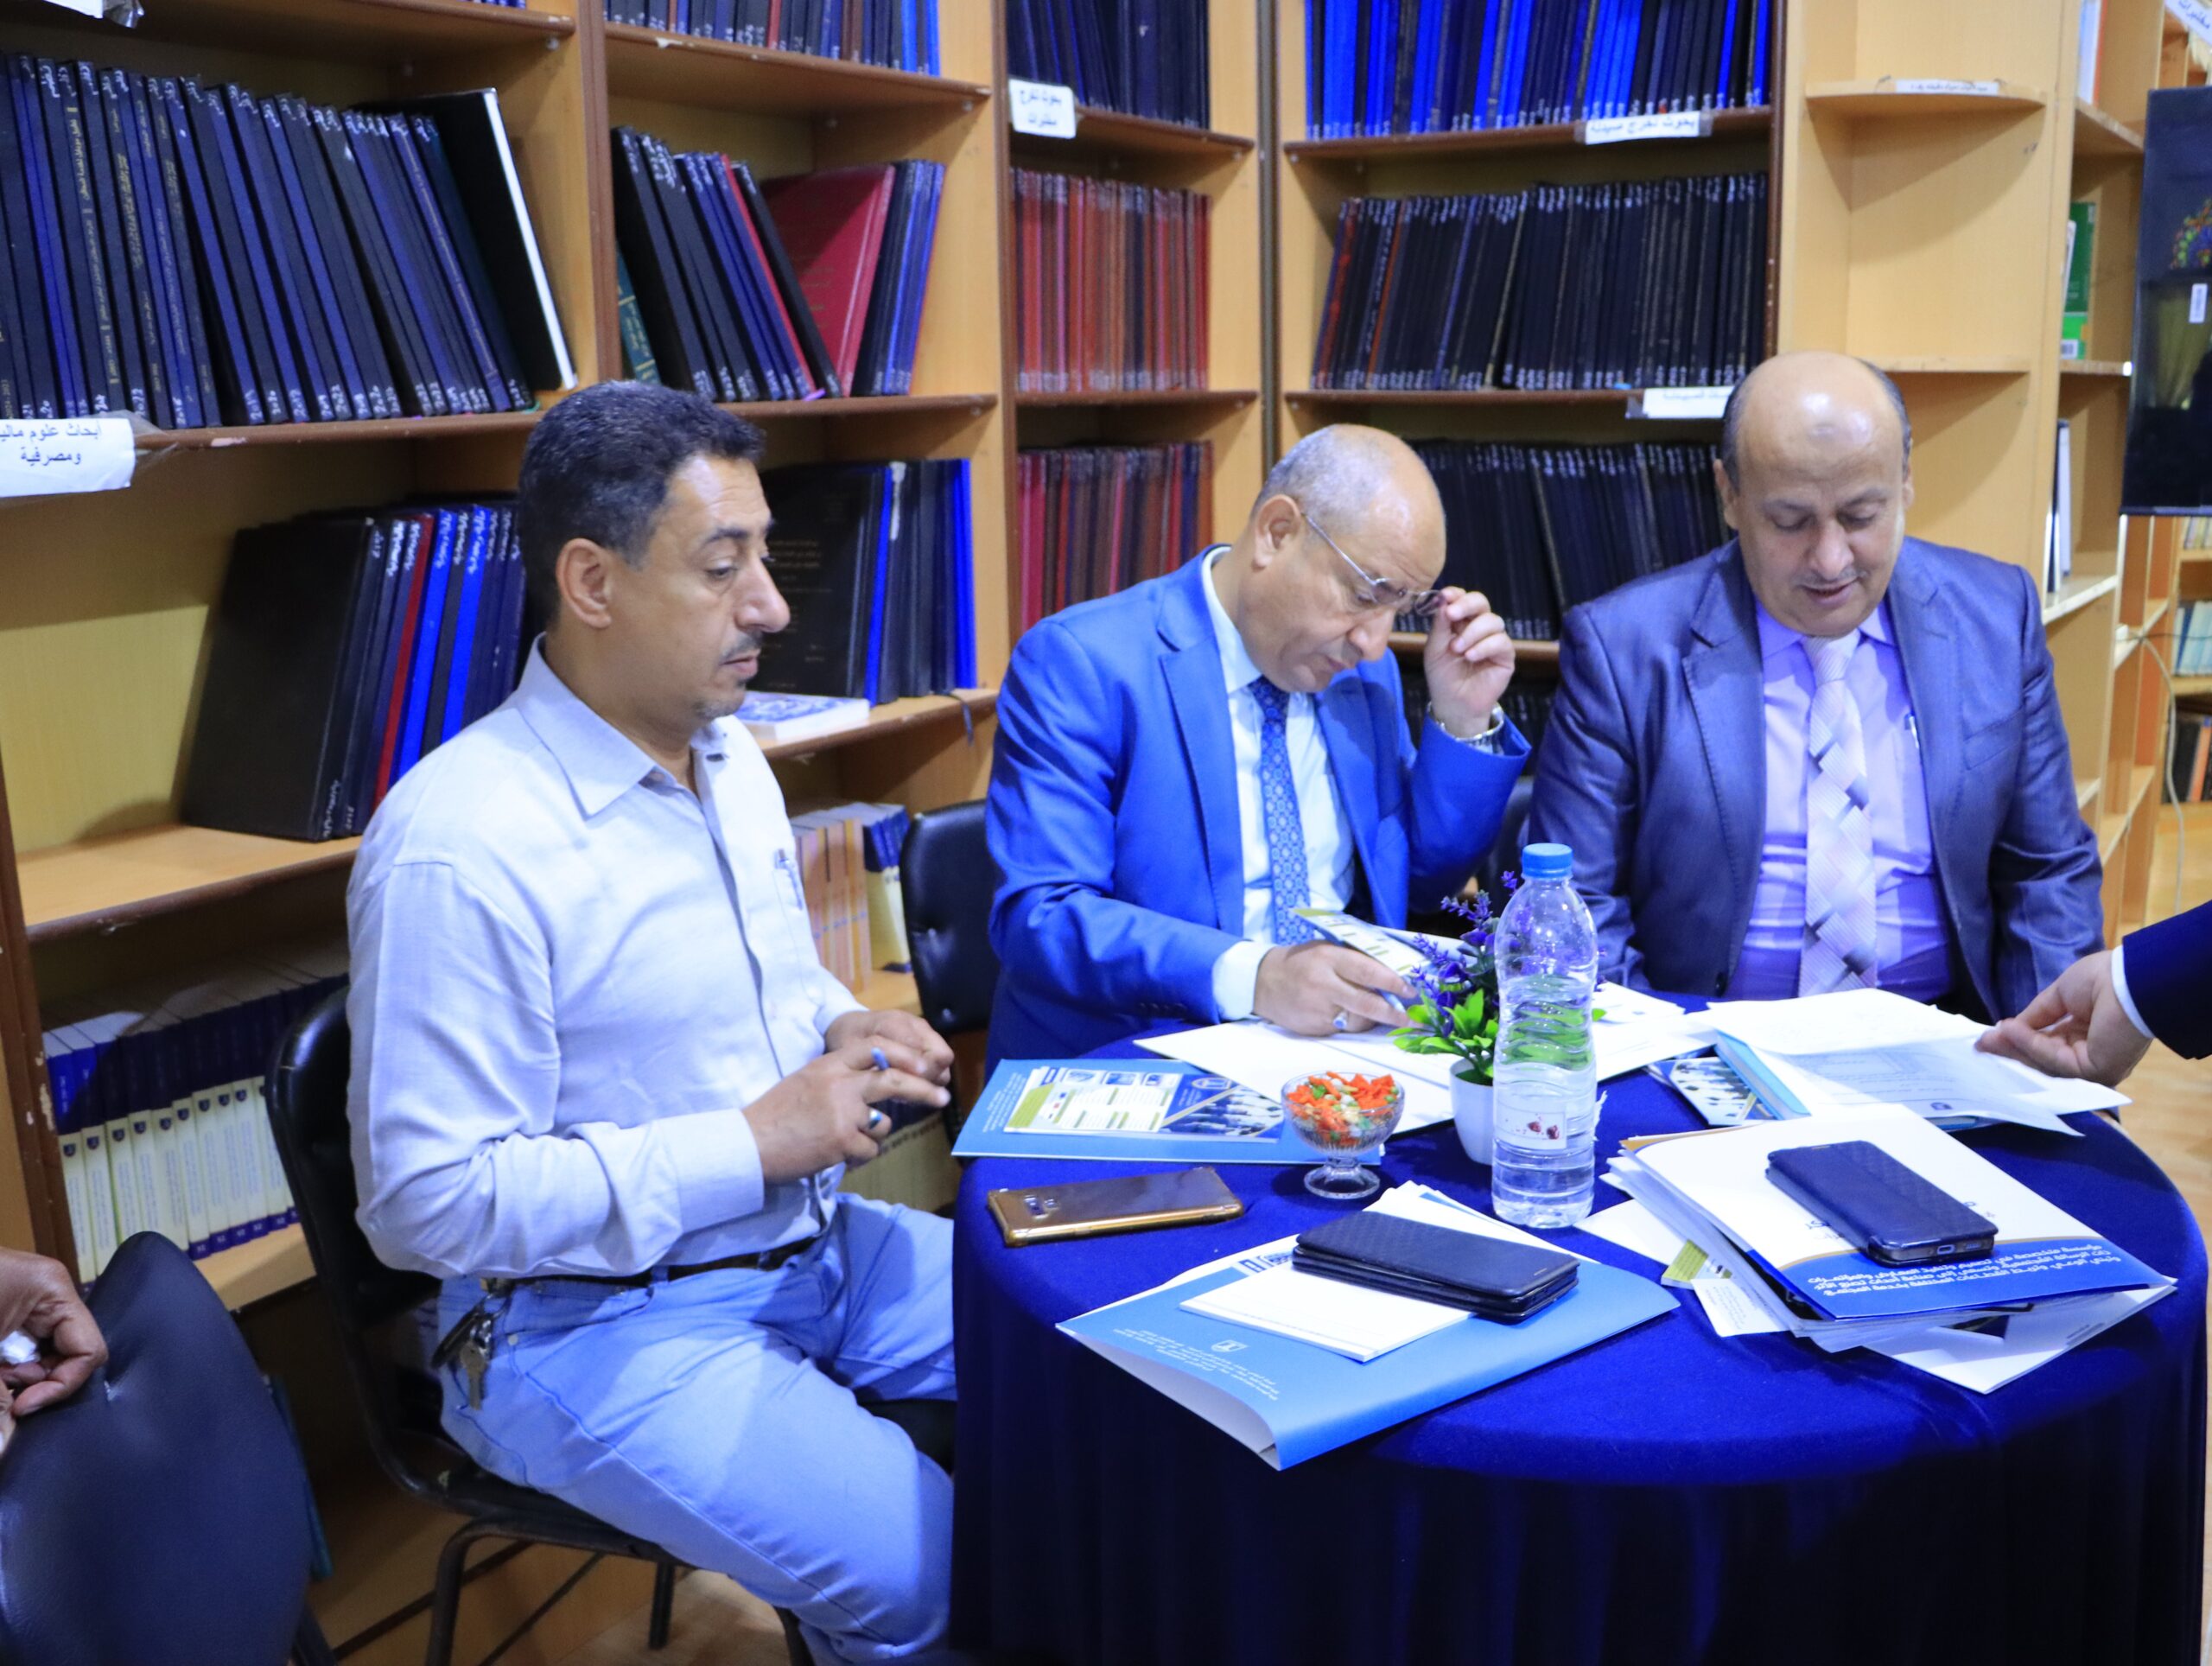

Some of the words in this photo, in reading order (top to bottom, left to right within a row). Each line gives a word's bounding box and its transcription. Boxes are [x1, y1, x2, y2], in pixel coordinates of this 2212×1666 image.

[0, 424, 24, 442] مالي
[29, 424, 59, 442] علوم
[21, 447, 81, 467] ومصرفية
[2061, 1244, 2102, 1253] مؤسسة
[1995, 1256, 2013, 1264] في
